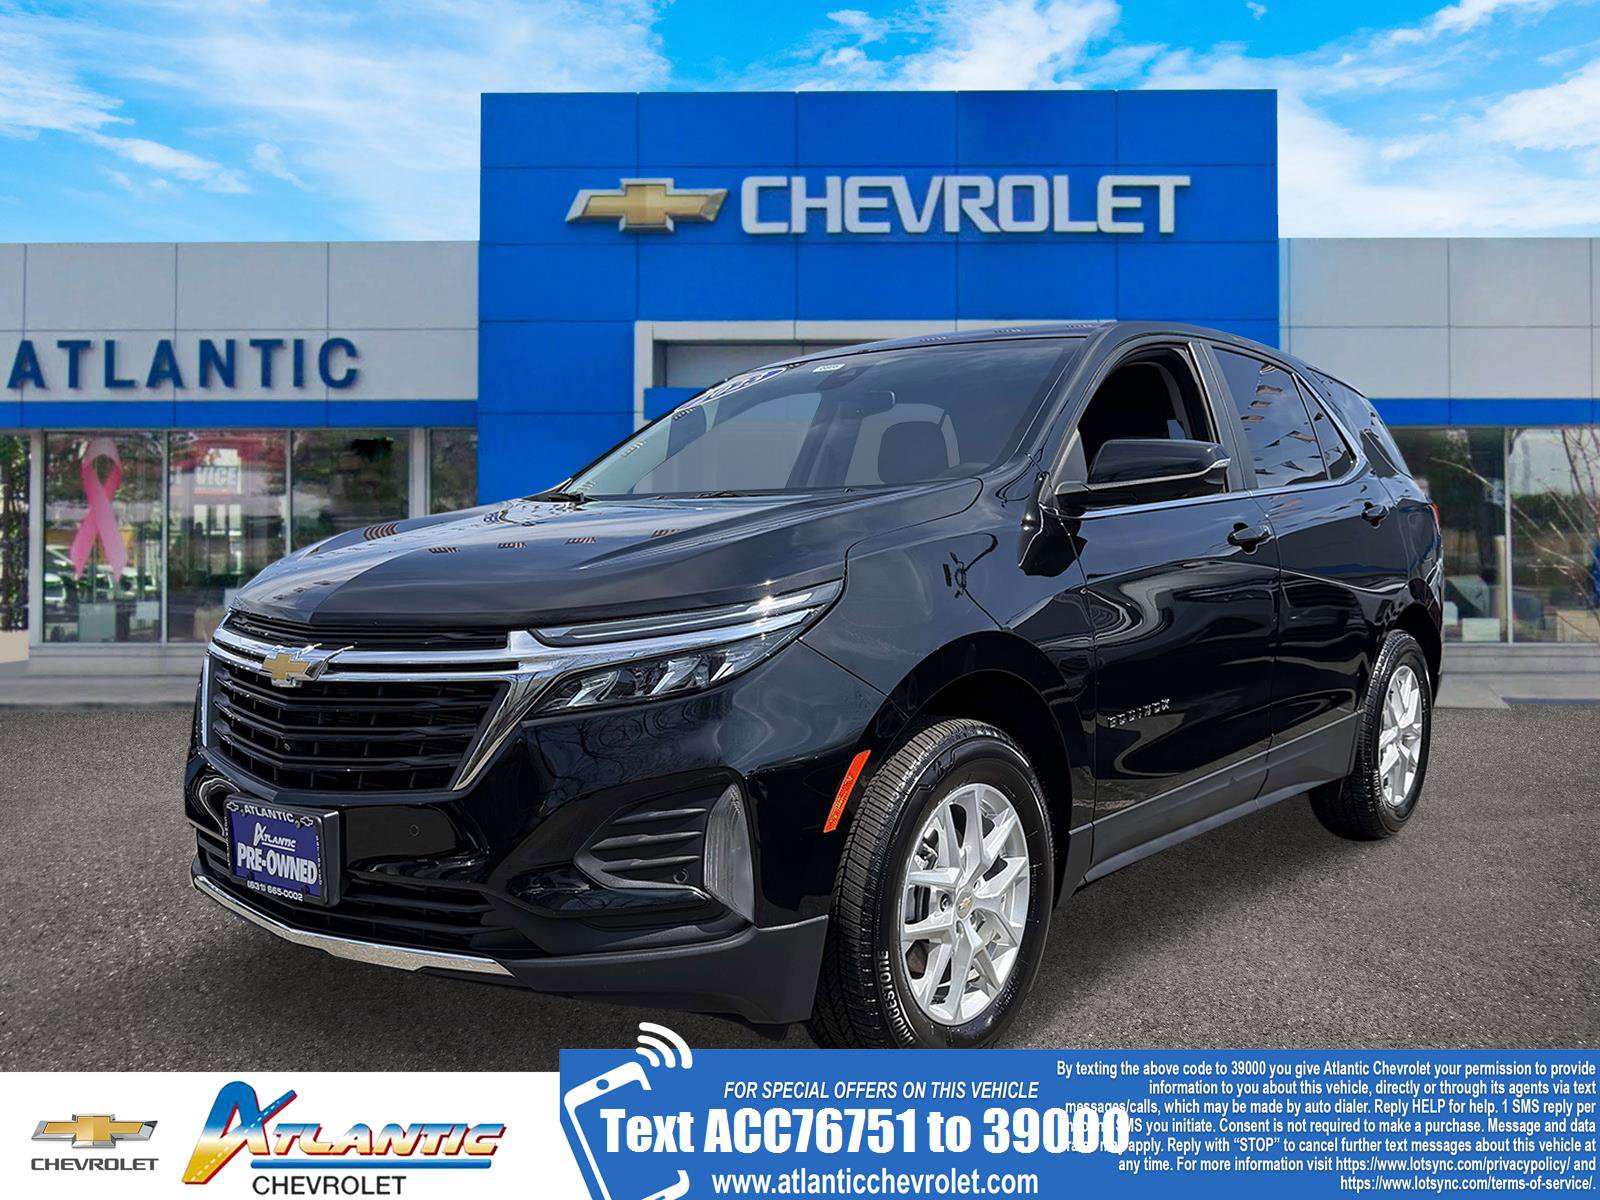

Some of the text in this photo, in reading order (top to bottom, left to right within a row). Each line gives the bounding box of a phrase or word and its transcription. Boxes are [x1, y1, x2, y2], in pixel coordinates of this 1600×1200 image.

[741, 174, 1192, 234] CHEVROLET
[6, 337, 361, 390] ATLANTIC
[243, 804, 295, 823] ATLANTIC
[236, 842, 319, 885] PRE-OWNED
